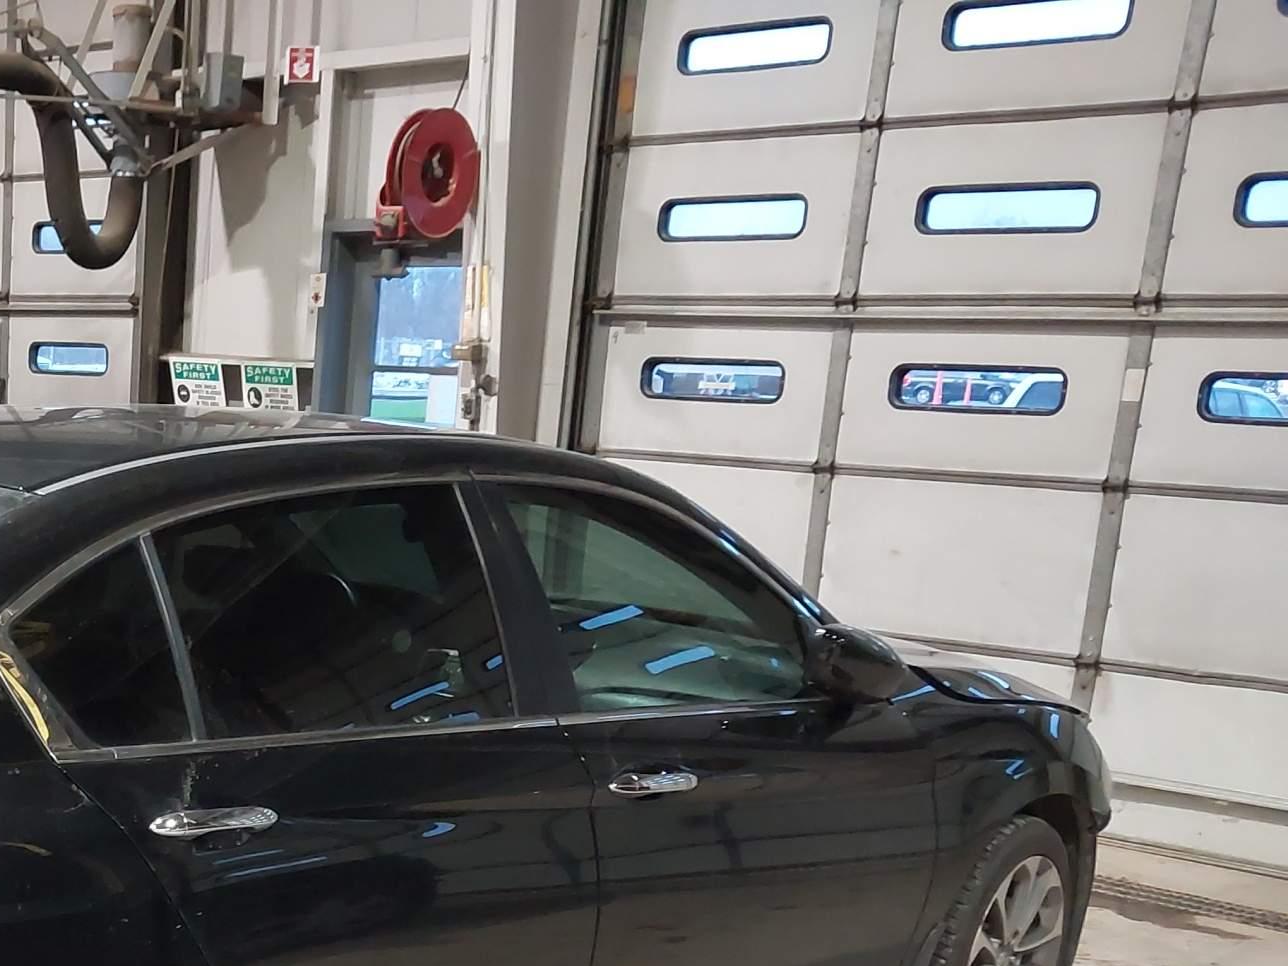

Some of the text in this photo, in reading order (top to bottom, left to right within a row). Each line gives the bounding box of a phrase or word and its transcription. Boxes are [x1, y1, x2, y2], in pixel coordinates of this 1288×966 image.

[175, 362, 216, 375] SAFETY
[246, 366, 291, 379] SAFETY
[182, 371, 211, 380] FIRST
[254, 375, 285, 384] FIRST
